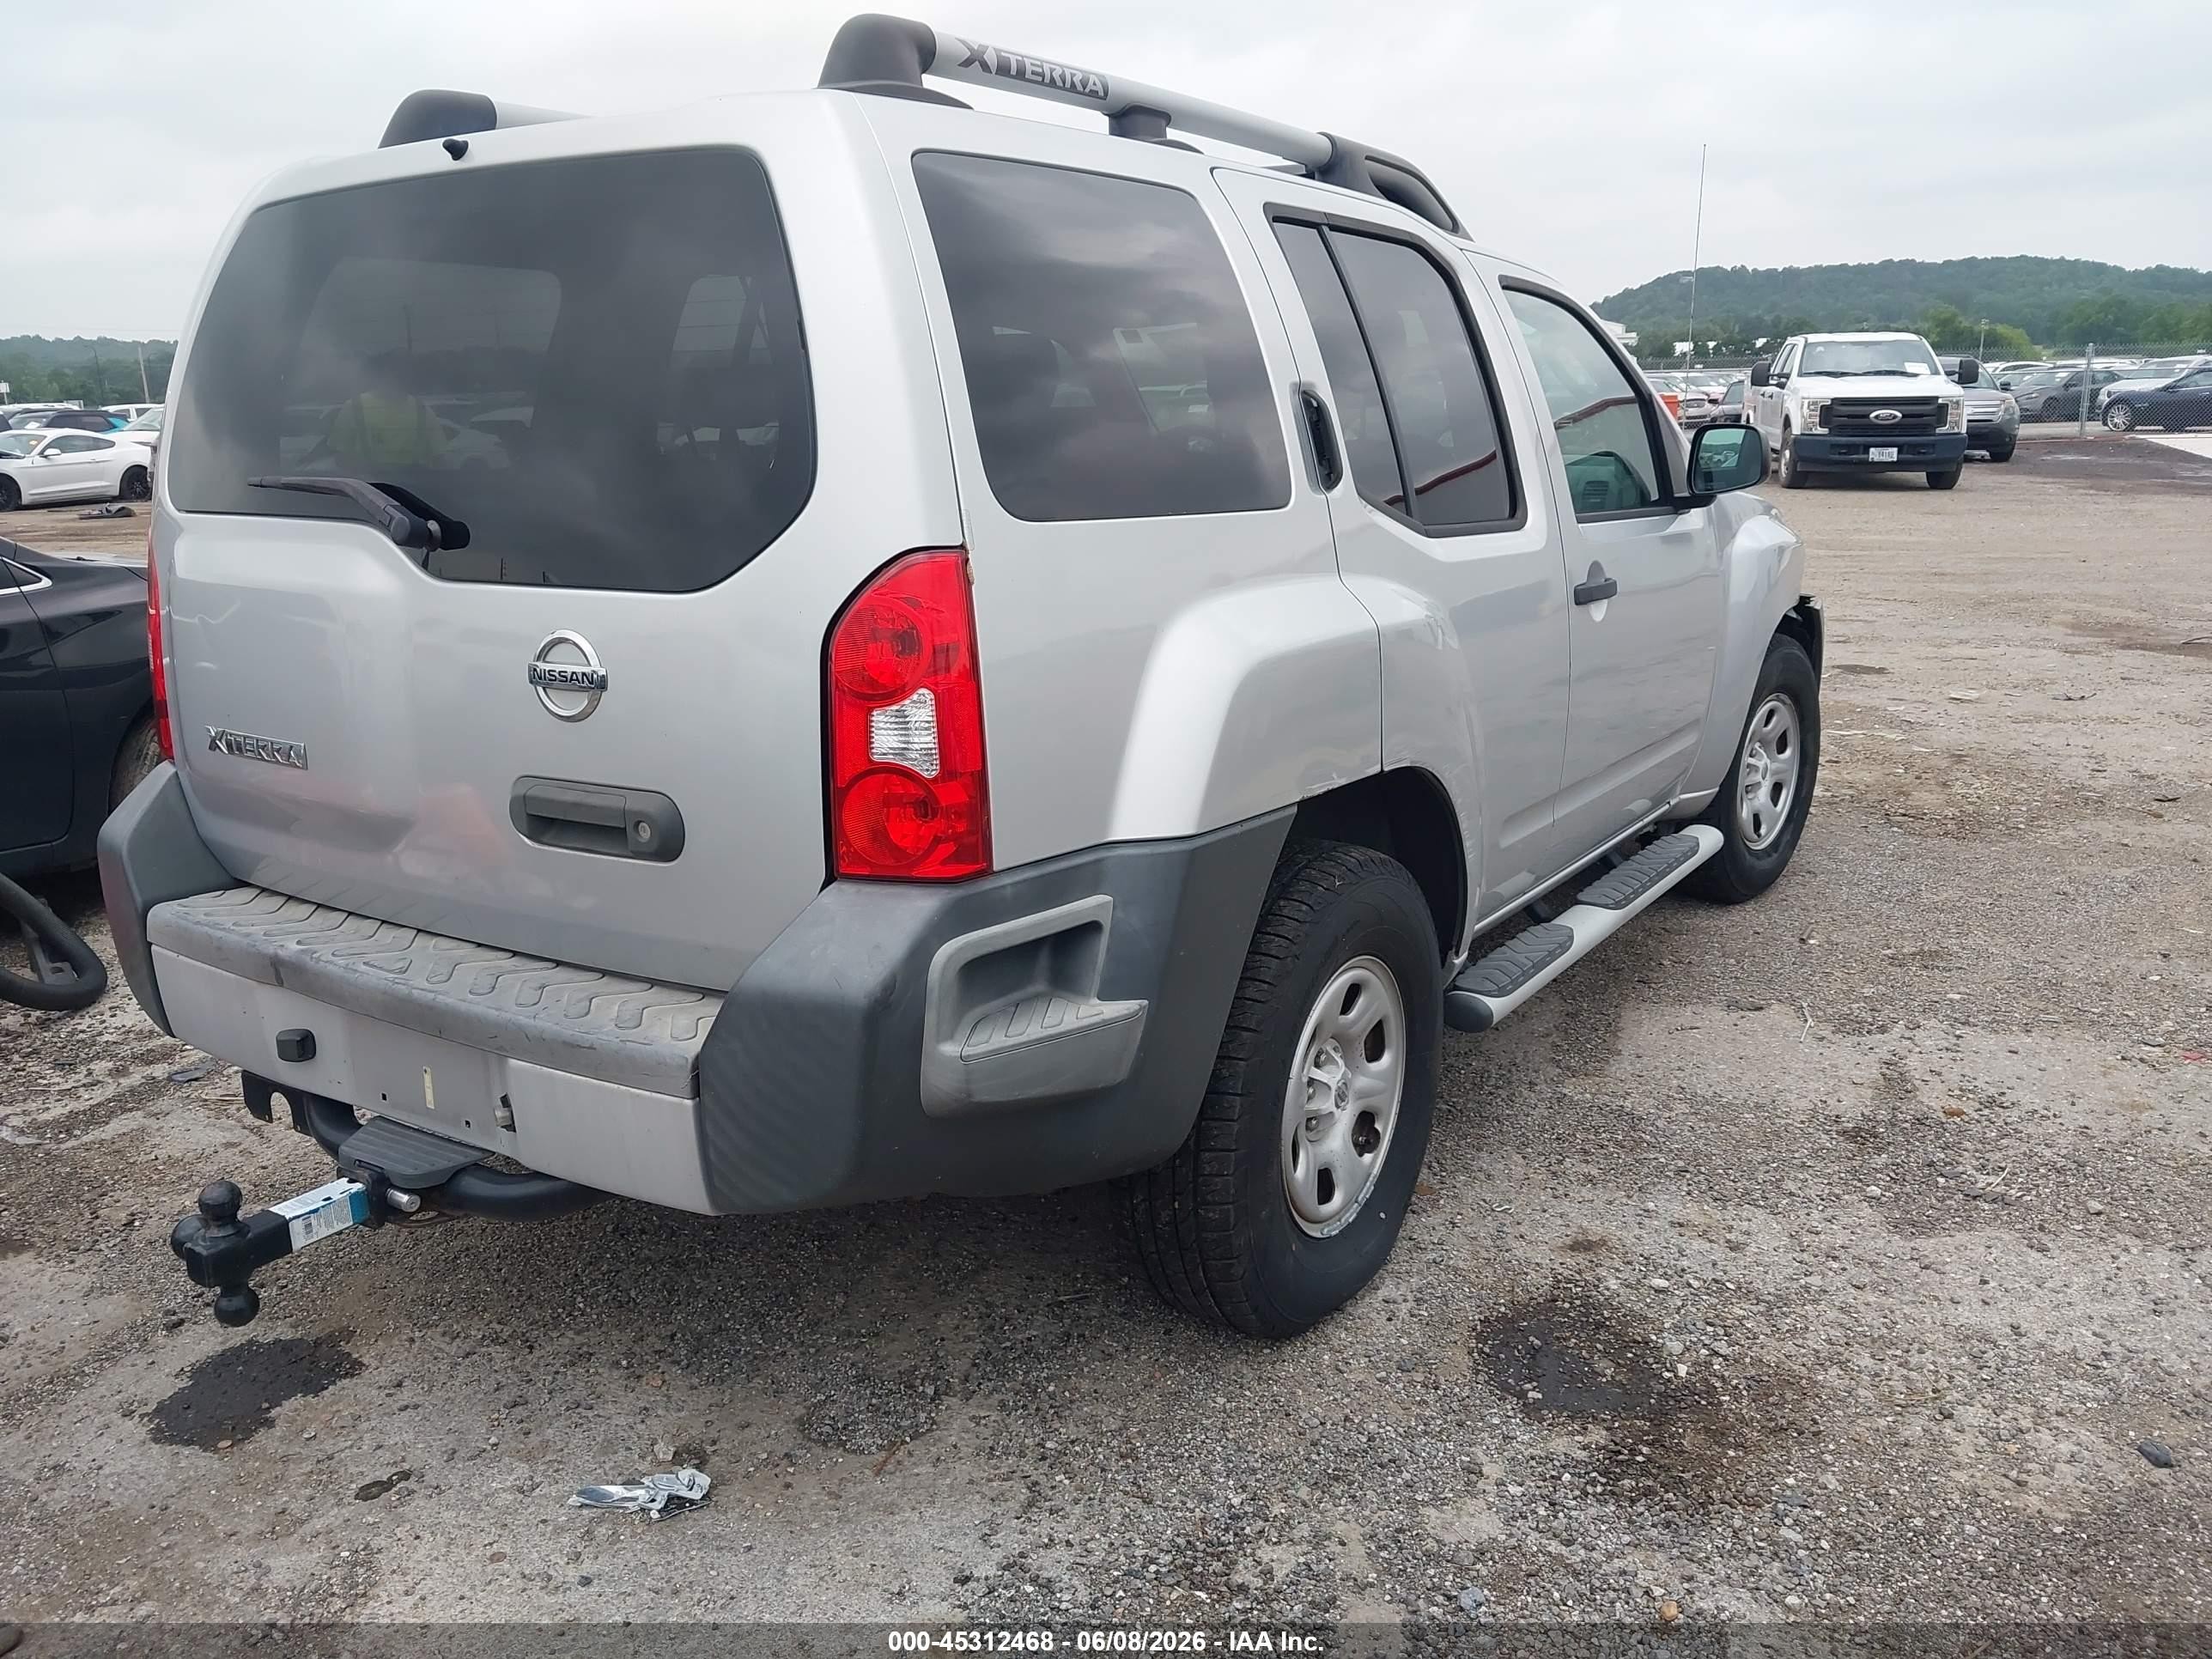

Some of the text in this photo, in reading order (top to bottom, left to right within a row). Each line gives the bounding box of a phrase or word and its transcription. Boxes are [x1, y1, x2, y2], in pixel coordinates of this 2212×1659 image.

[954, 37, 1107, 98] XTERRA
[532, 667, 594, 685] NISSAN
[205, 726, 307, 769] XTERRA
